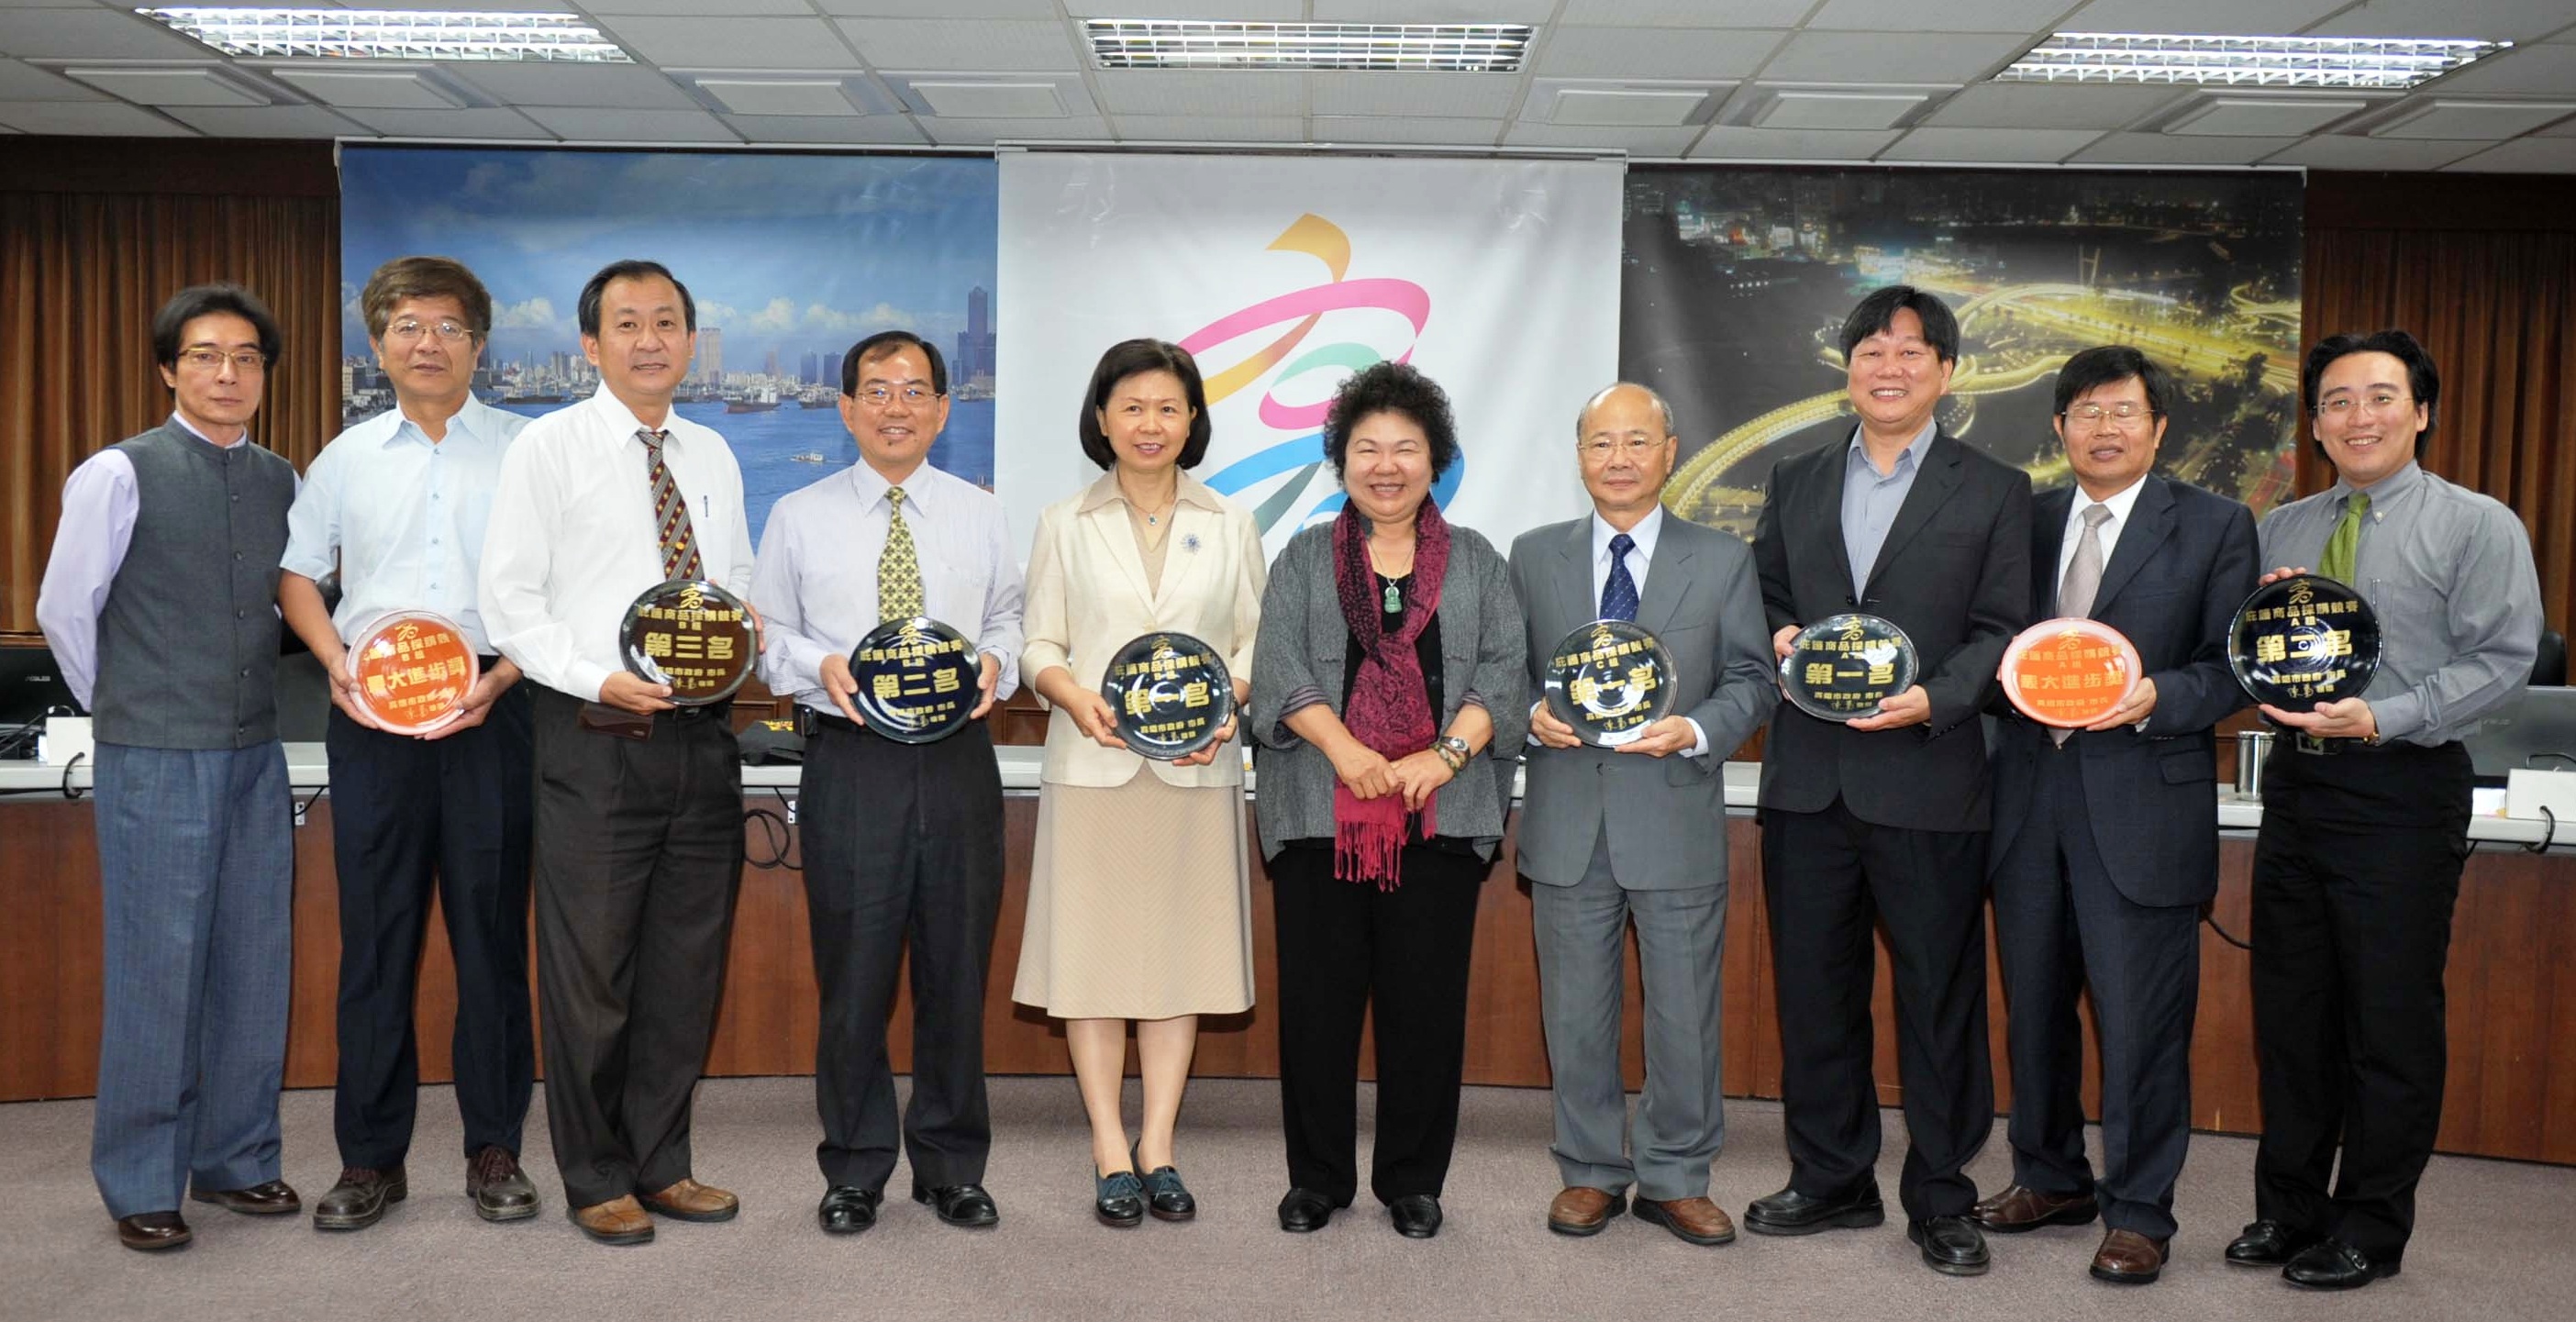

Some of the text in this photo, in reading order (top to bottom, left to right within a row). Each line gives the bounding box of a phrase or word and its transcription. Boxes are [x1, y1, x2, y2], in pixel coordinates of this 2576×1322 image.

[645, 631, 734, 660] 第三名
[2256, 629, 2353, 662] 第二名
[872, 668, 960, 699] 第二名
[1570, 666, 1657, 705] 第一名
[1805, 662, 1894, 685] 第一名
[1125, 682, 1210, 716] 第一名
